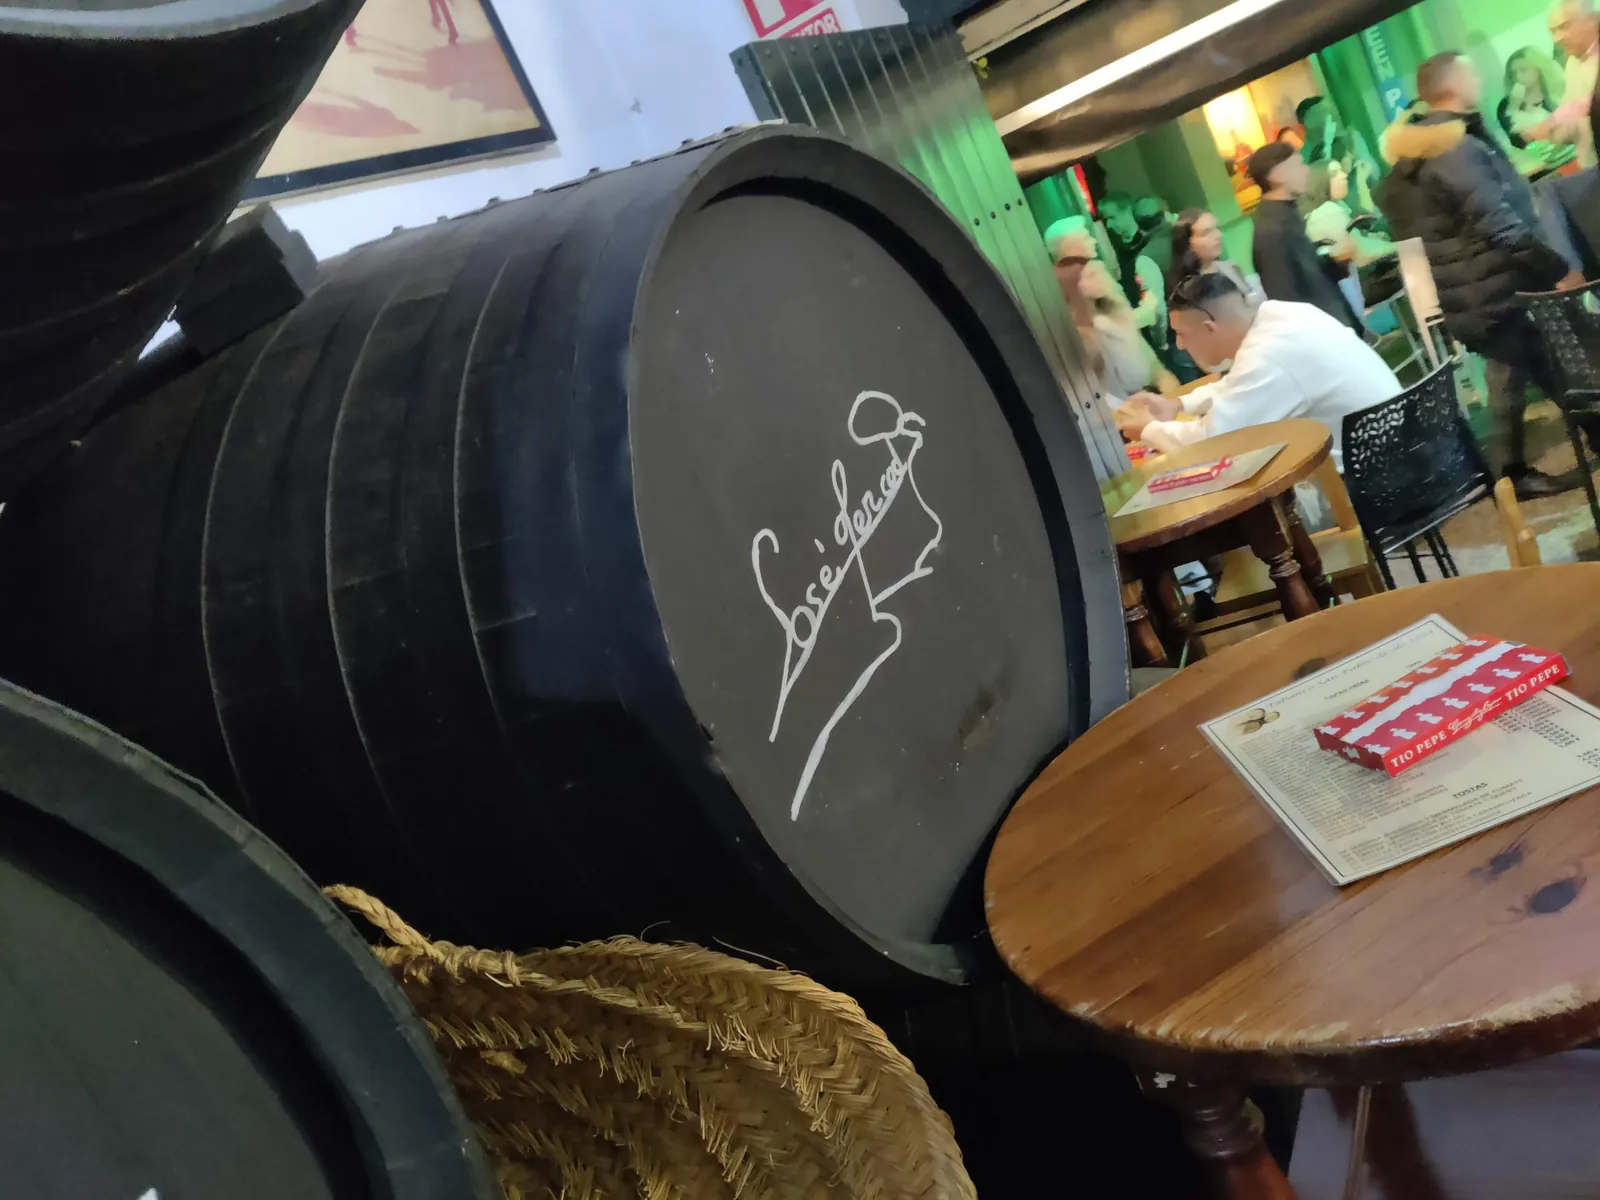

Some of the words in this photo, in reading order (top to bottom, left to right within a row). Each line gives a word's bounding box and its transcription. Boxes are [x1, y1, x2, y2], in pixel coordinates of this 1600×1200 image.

[1391, 750, 1414, 768] TIO
[1416, 730, 1447, 754] PEPE
[1505, 684, 1528, 702] TIO
[1529, 663, 1561, 687] PEPE
[1453, 781, 1489, 798] TOSTAS
